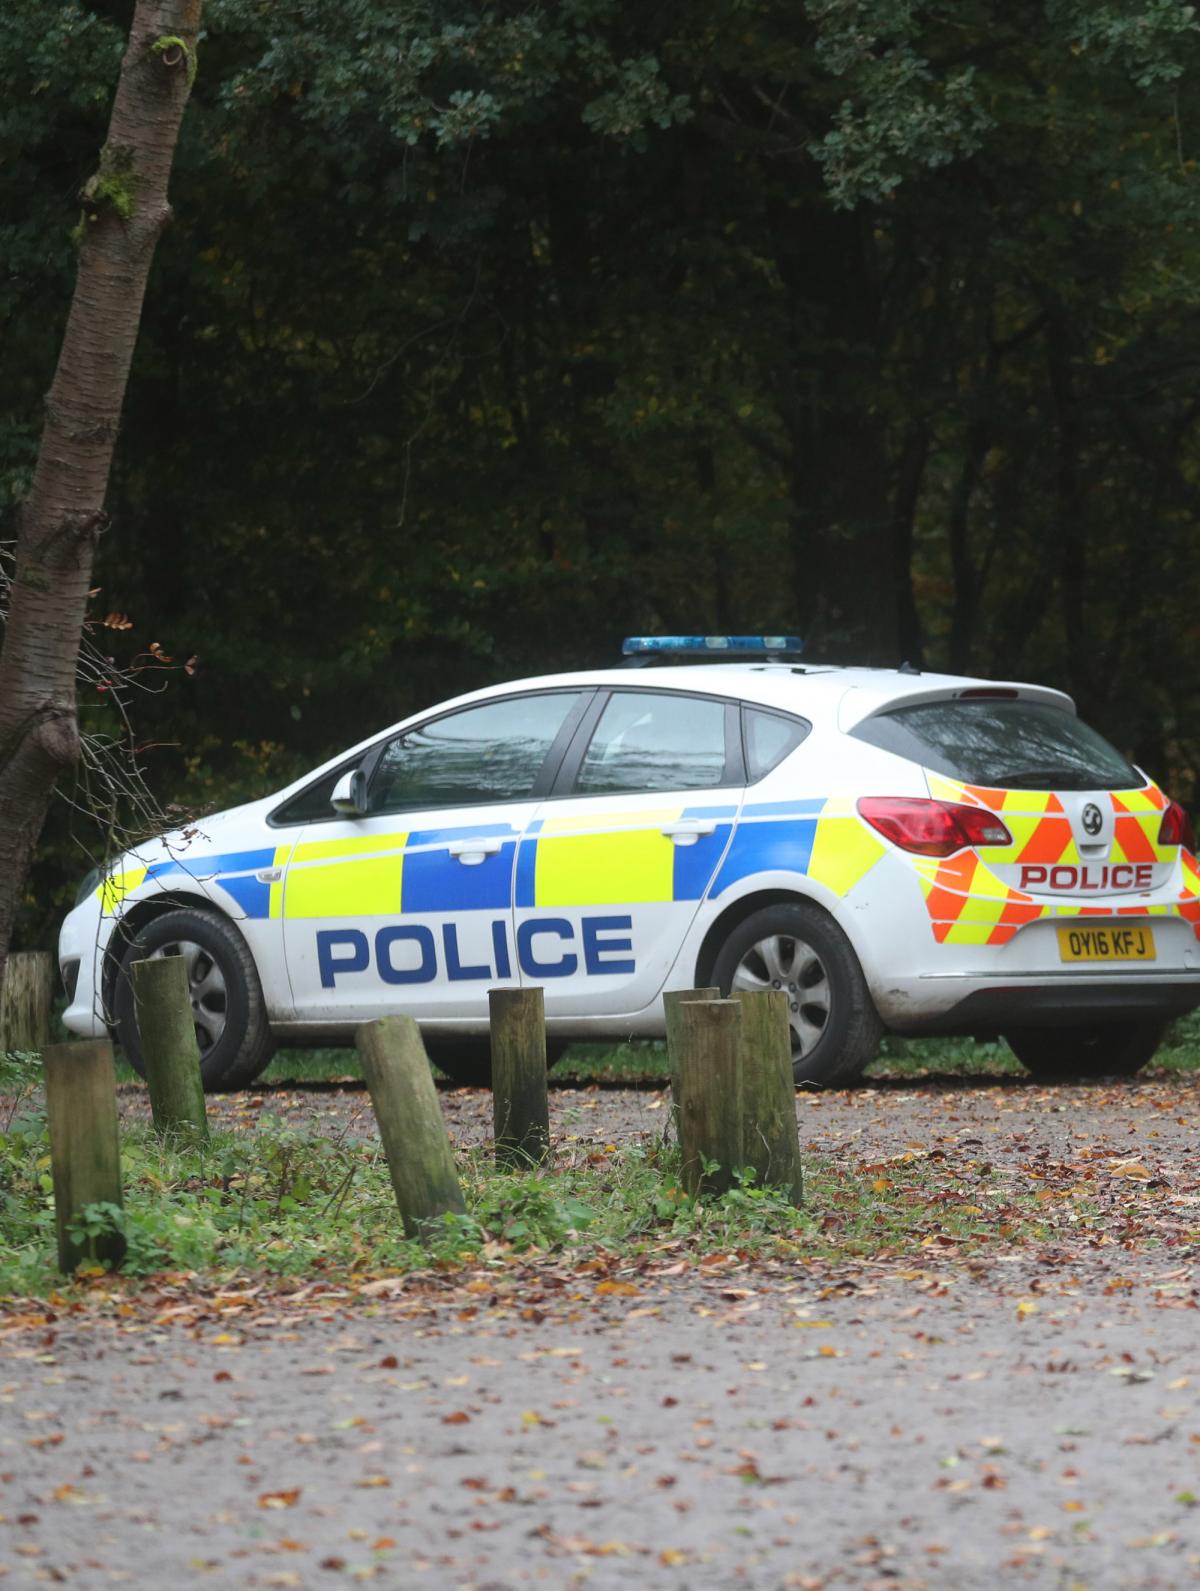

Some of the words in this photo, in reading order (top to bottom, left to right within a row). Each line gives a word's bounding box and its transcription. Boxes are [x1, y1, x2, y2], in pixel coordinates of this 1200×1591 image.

[1020, 865, 1153, 889] POLICE
[316, 915, 636, 988] POLICE
[1069, 931, 1107, 956] OY16
[1111, 931, 1146, 955] KFJ
